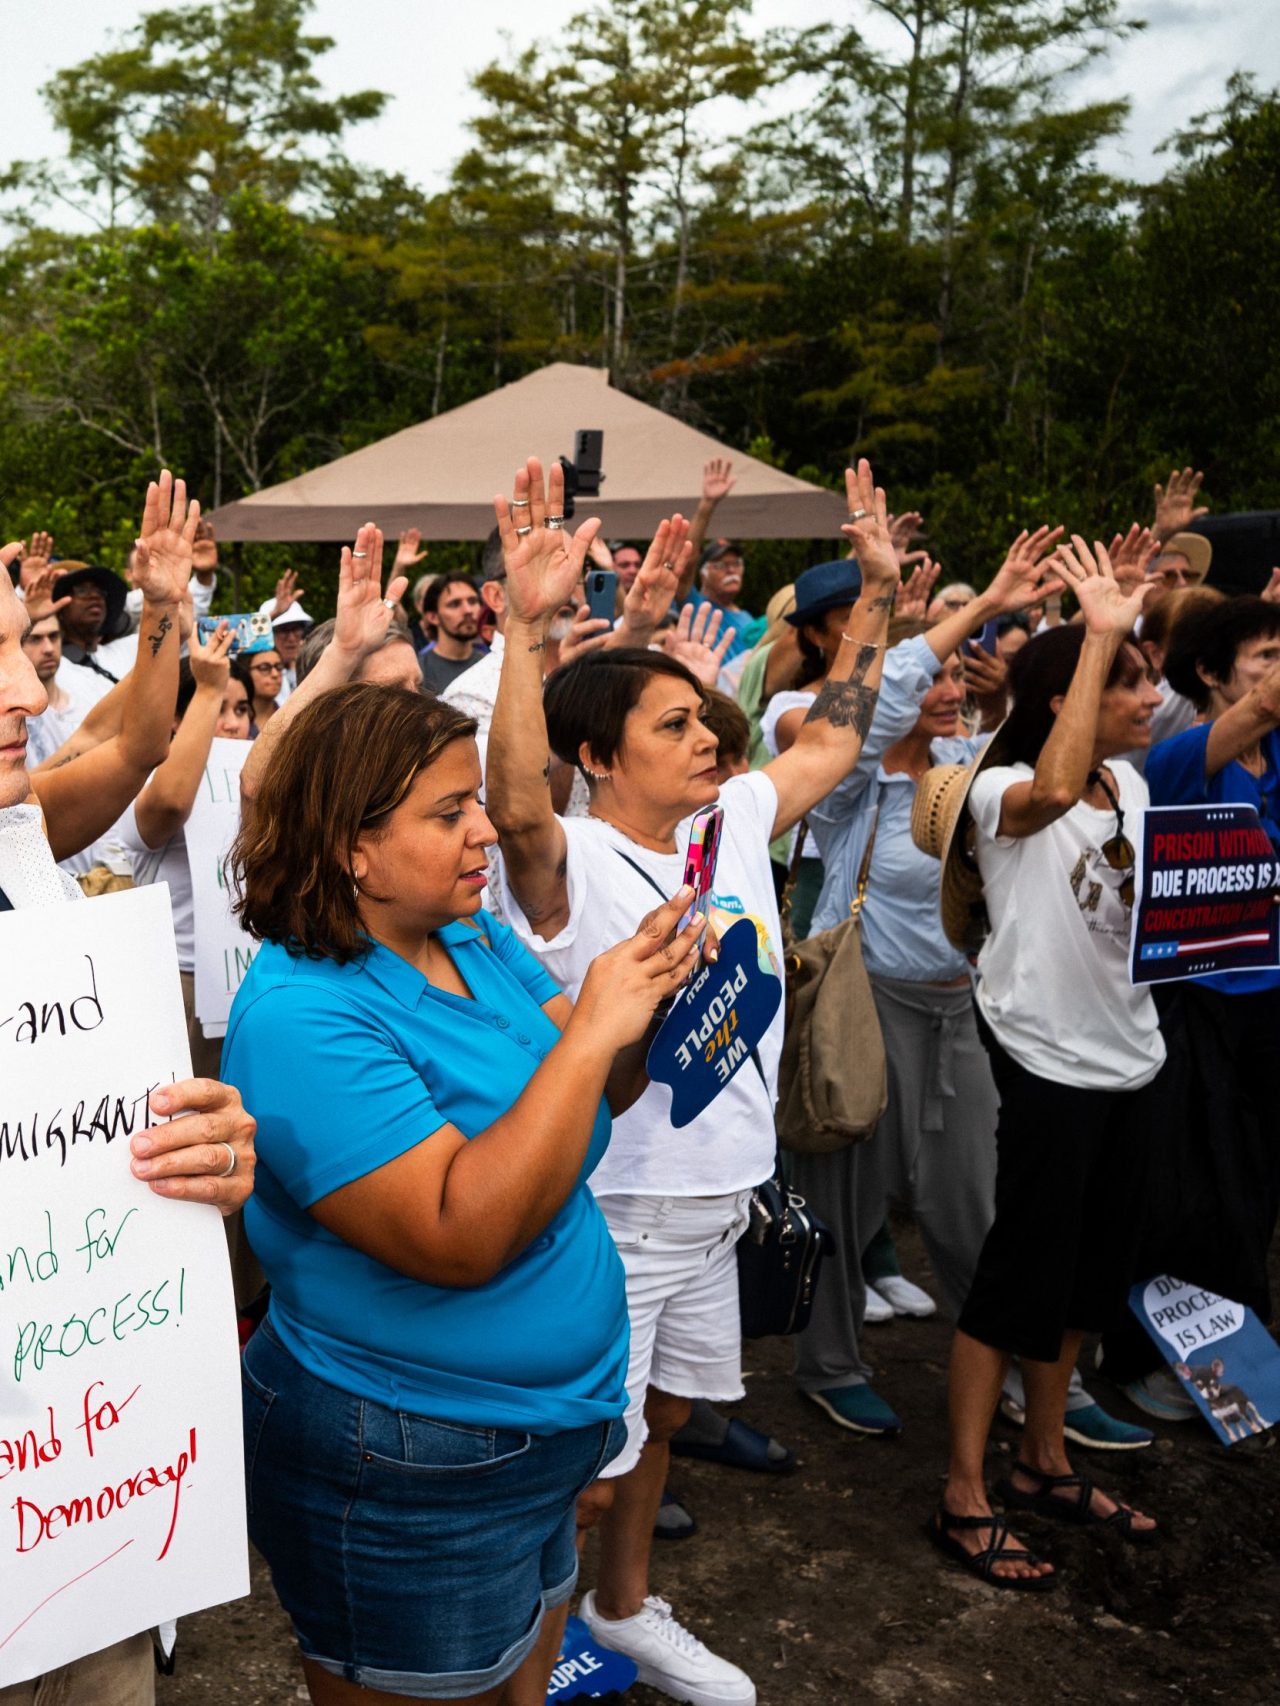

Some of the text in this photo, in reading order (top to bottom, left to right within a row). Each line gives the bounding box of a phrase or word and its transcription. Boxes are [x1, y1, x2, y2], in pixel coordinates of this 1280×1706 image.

[1154, 829, 1273, 861] PRISON WITHOU
[1151, 869, 1183, 899] DUE
[1185, 864, 1255, 896] PROCESS
[1257, 862, 1272, 889] IS
[686, 965, 710, 1005] ACLU
[674, 963, 748, 1071] PEOPLE
[704, 1008, 740, 1063] the
[714, 1035, 748, 1083] WE
[76, 1207, 139, 1277] for
[1154, 1275, 1187, 1297] DU
[13, 1268, 187, 1382] PROCESS!
[1152, 1291, 1223, 1328] PROCE
[1175, 1310, 1236, 1349] IS LAW
[75, 1381, 142, 1457] for
[546, 1651, 604, 1695] EOPLE
